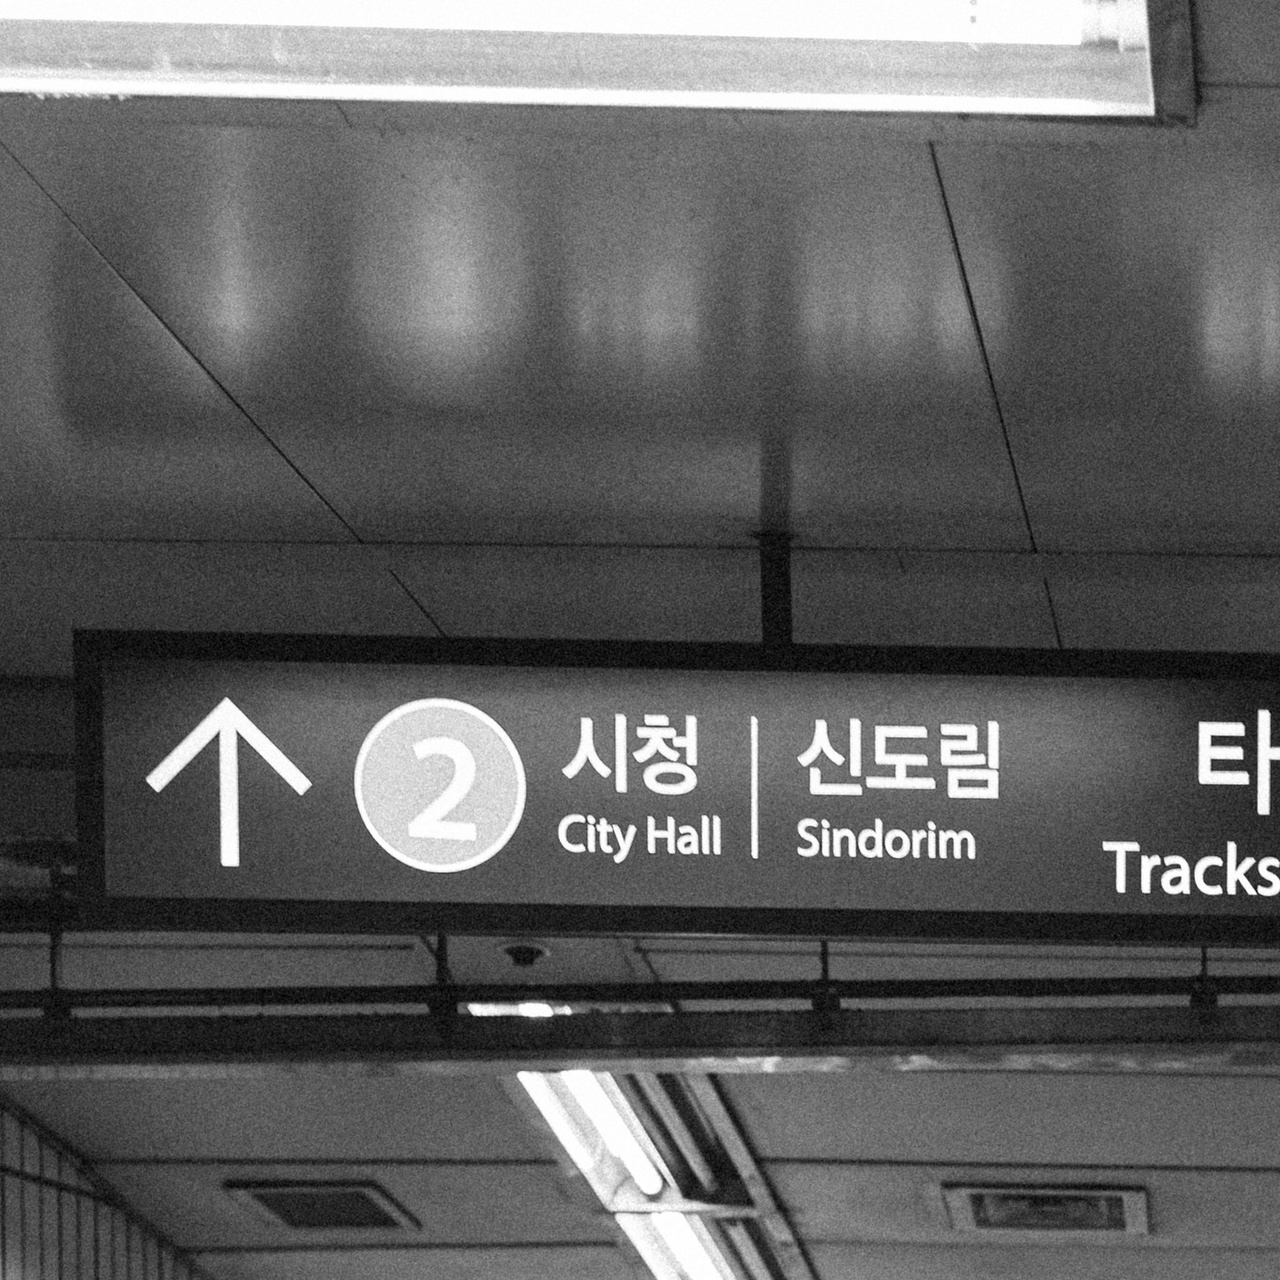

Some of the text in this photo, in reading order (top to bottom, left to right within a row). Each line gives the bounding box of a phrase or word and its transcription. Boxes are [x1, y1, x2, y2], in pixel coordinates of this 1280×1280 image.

[408, 736, 477, 842] 2
[562, 713, 698, 795] 시청
[797, 717, 1000, 799] 신도림
[557, 813, 722, 864] City Hall
[797, 817, 976, 860] Sindorim
